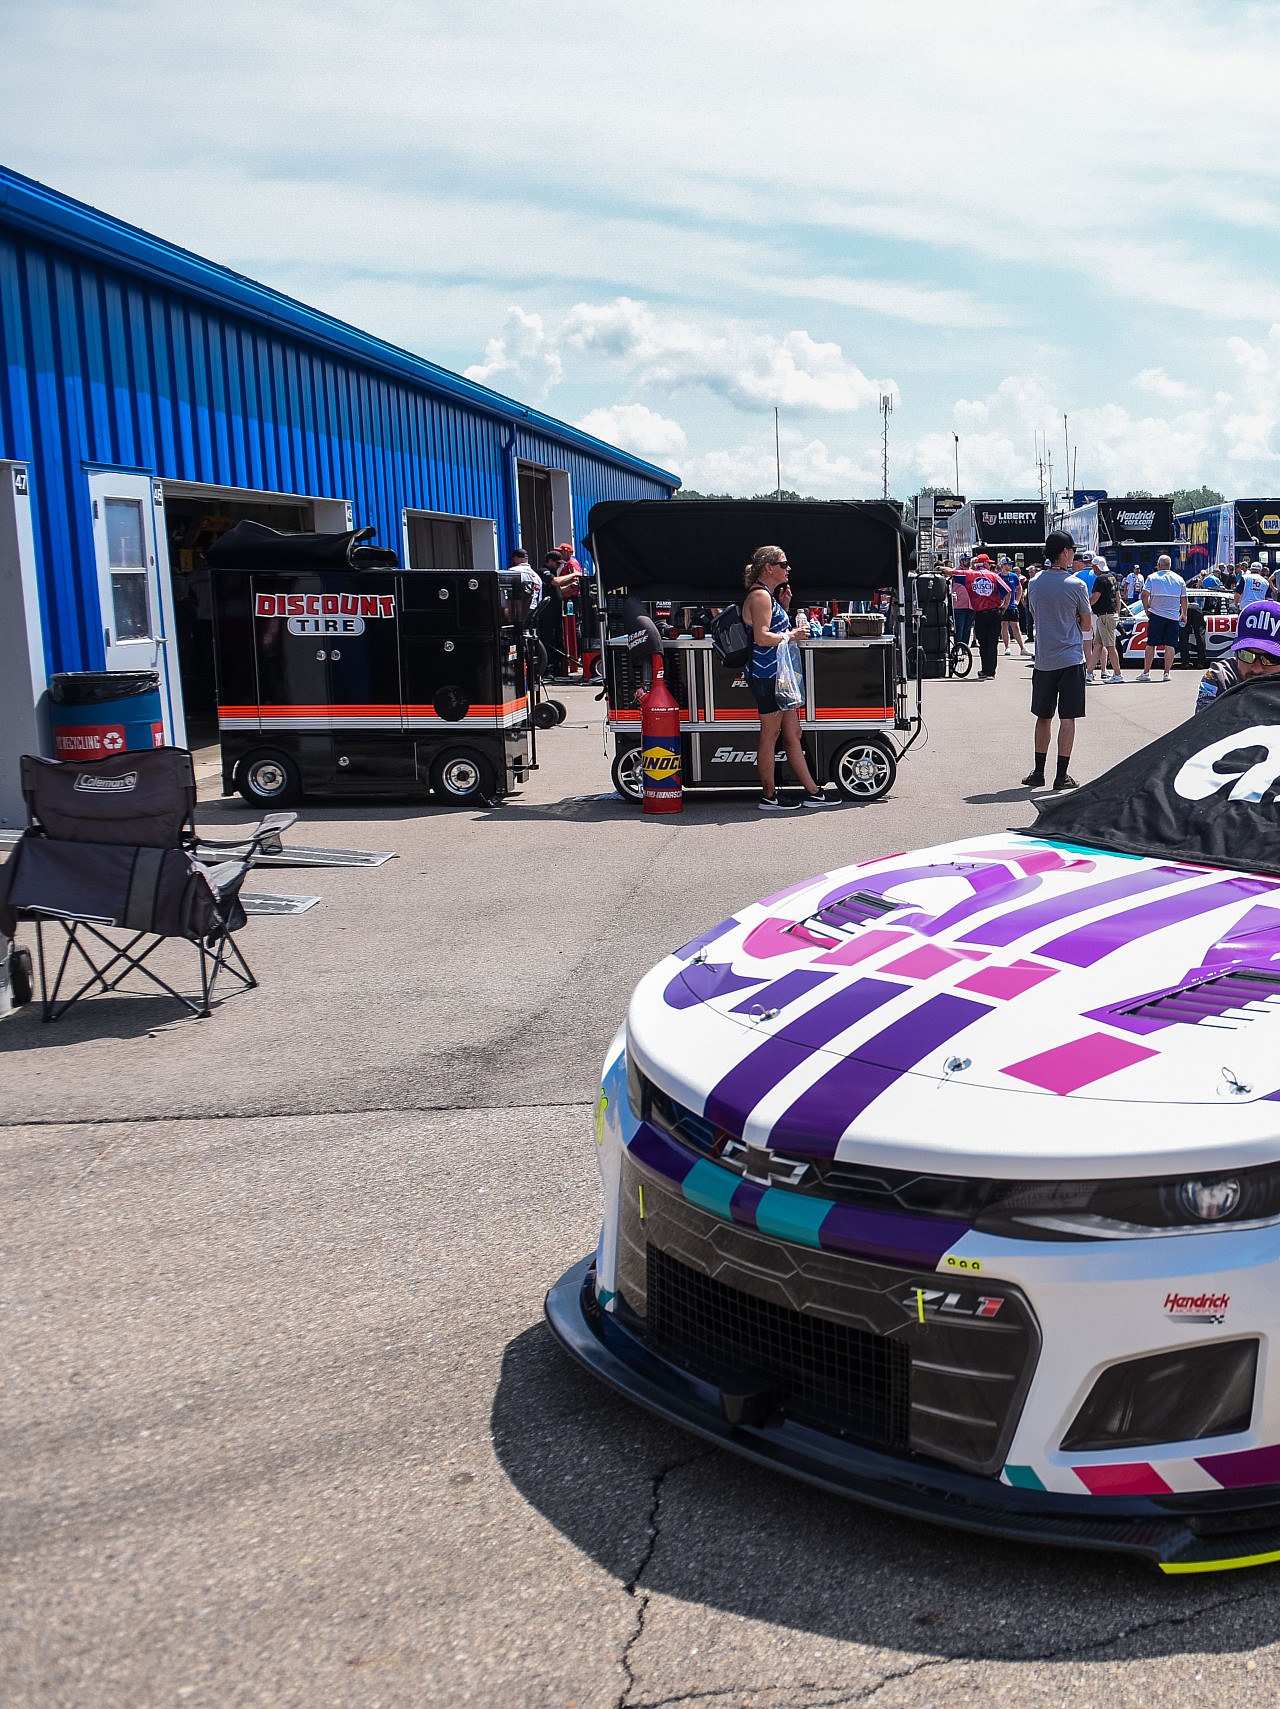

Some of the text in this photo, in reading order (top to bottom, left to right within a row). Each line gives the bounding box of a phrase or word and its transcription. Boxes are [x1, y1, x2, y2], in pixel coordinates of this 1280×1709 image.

[15, 475, 26, 489] 47
[998, 512, 1037, 520] LIBERTY
[1116, 510, 1156, 522] Hendrick
[1124, 518, 1154, 526] cars.com
[1263, 520, 1279, 530] NAPA
[255, 593, 396, 618] DISCOUNT
[296, 619, 355, 632] TIRE
[80, 775, 124, 788] Coleman
[1164, 1293, 1230, 1313] Hendrick
